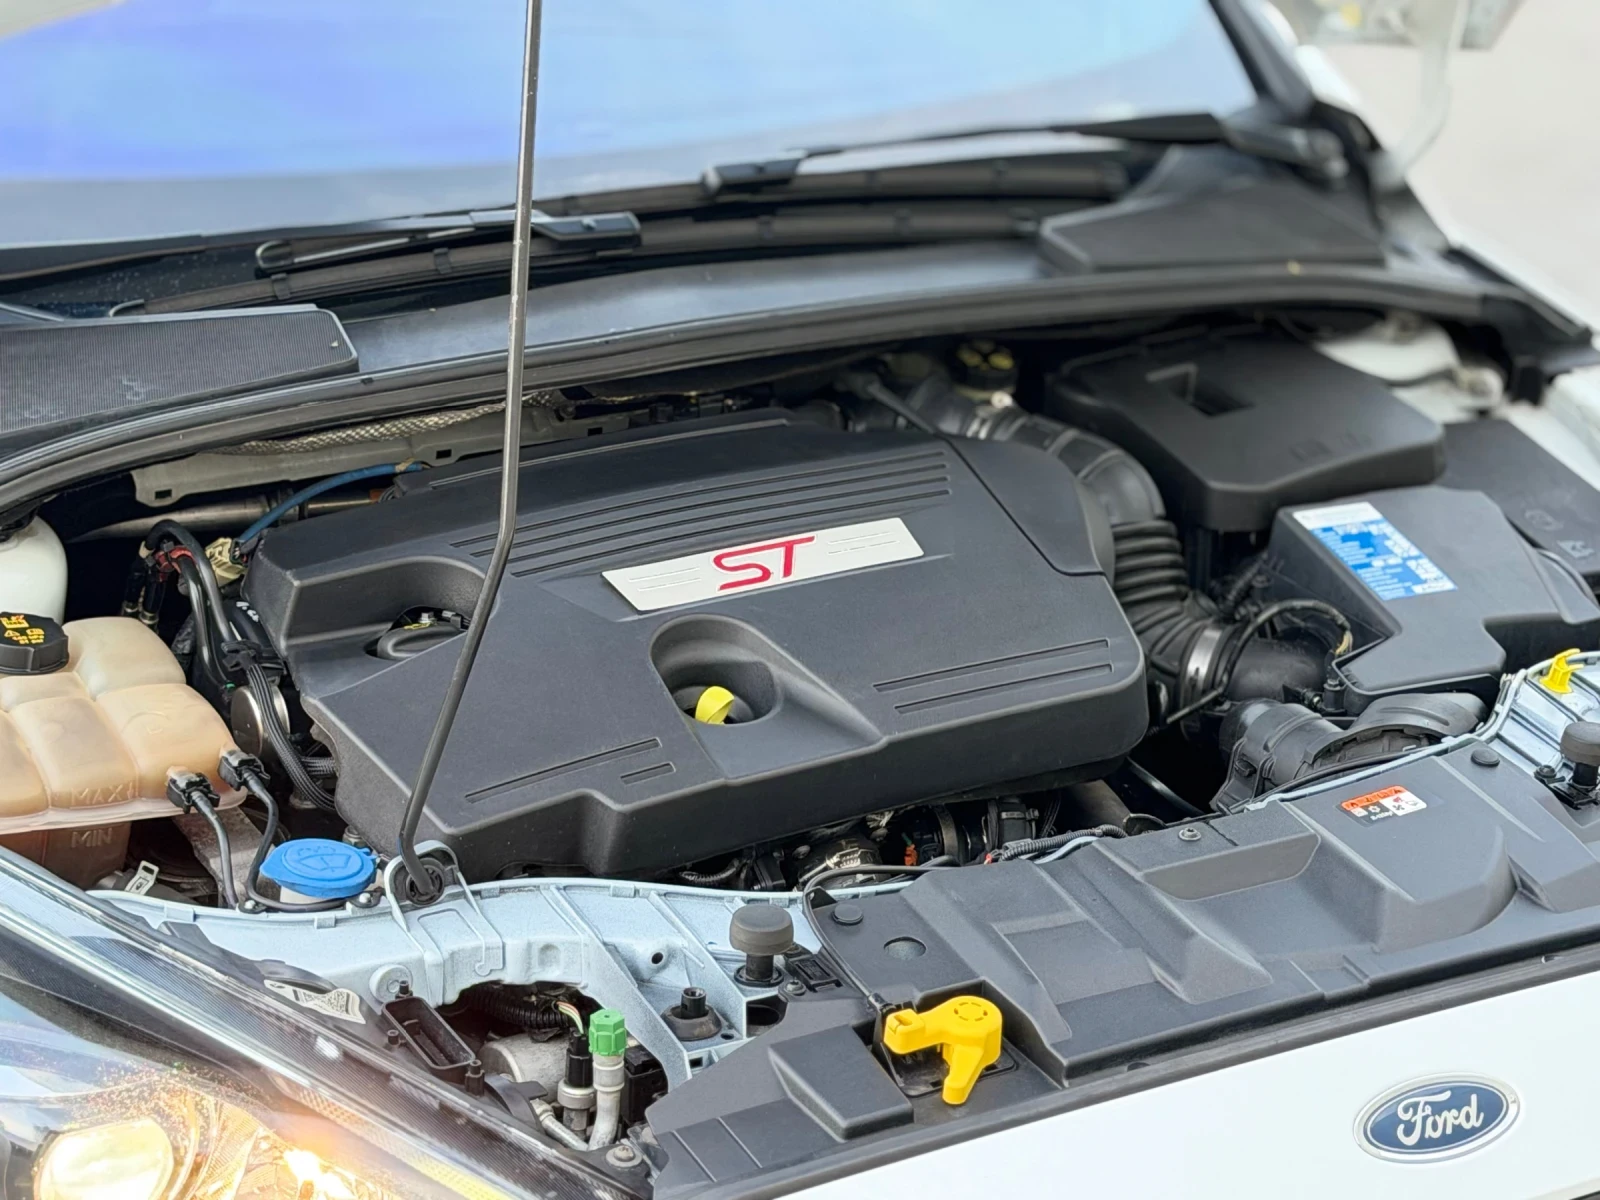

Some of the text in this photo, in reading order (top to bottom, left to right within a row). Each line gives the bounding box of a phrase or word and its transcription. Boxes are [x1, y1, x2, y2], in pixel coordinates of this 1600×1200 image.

[712, 535, 815, 591] ST
[71, 784, 124, 806] MAX
[71, 826, 113, 848] MIN
[1397, 1090, 1484, 1146] Ford
